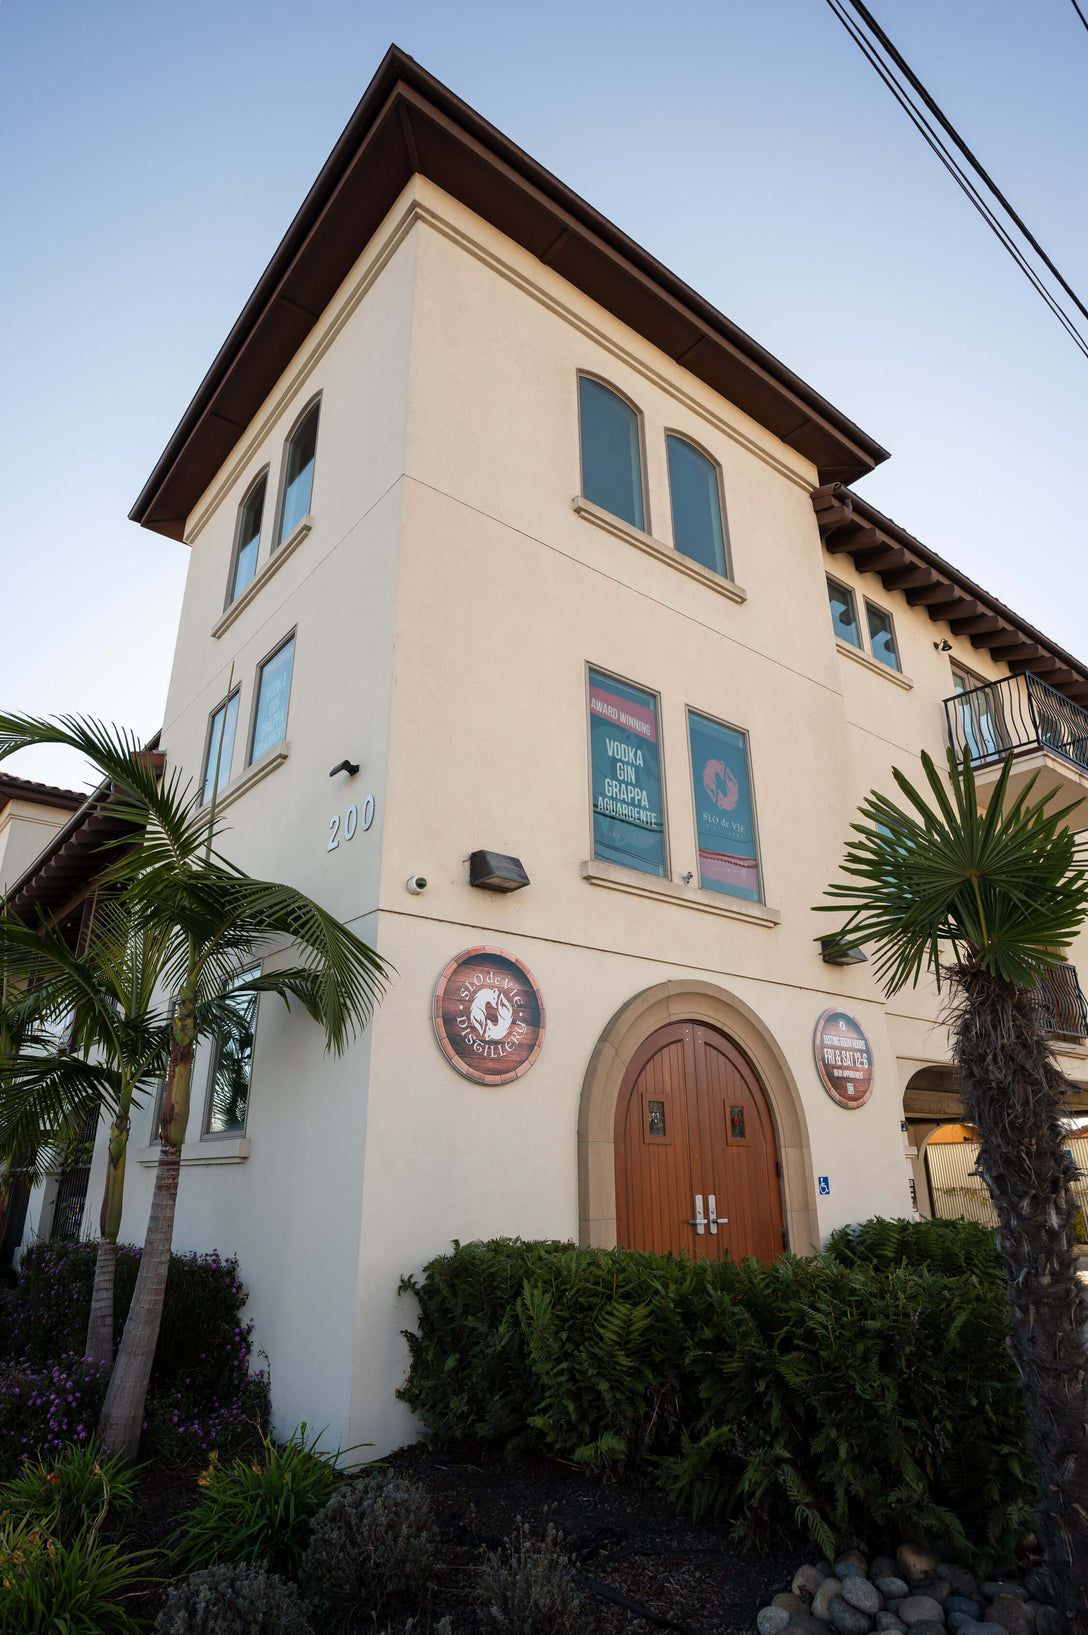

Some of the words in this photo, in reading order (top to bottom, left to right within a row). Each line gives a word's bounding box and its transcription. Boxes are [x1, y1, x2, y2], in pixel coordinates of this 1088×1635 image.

[590, 697, 618, 720] AWARD
[619, 711, 651, 736] WINNING
[606, 738, 644, 768] VODKA
[616, 762, 636, 785] GIN
[604, 778, 649, 809] GRAPPA
[327, 793, 375, 853] 200
[597, 796, 657, 828] AGUARDENTE
[702, 811, 719, 825] SLO
[720, 818, 730, 829] de
[731, 821, 747, 834] VIE
[459, 973, 484, 1000] SLO
[456, 1016, 528, 1058] DISTILLERY
[824, 1048, 835, 1065] FRI
[835, 1049, 842, 1066] &
[841, 1050, 854, 1067] SAT
[854, 1052, 869, 1069] 12-6
